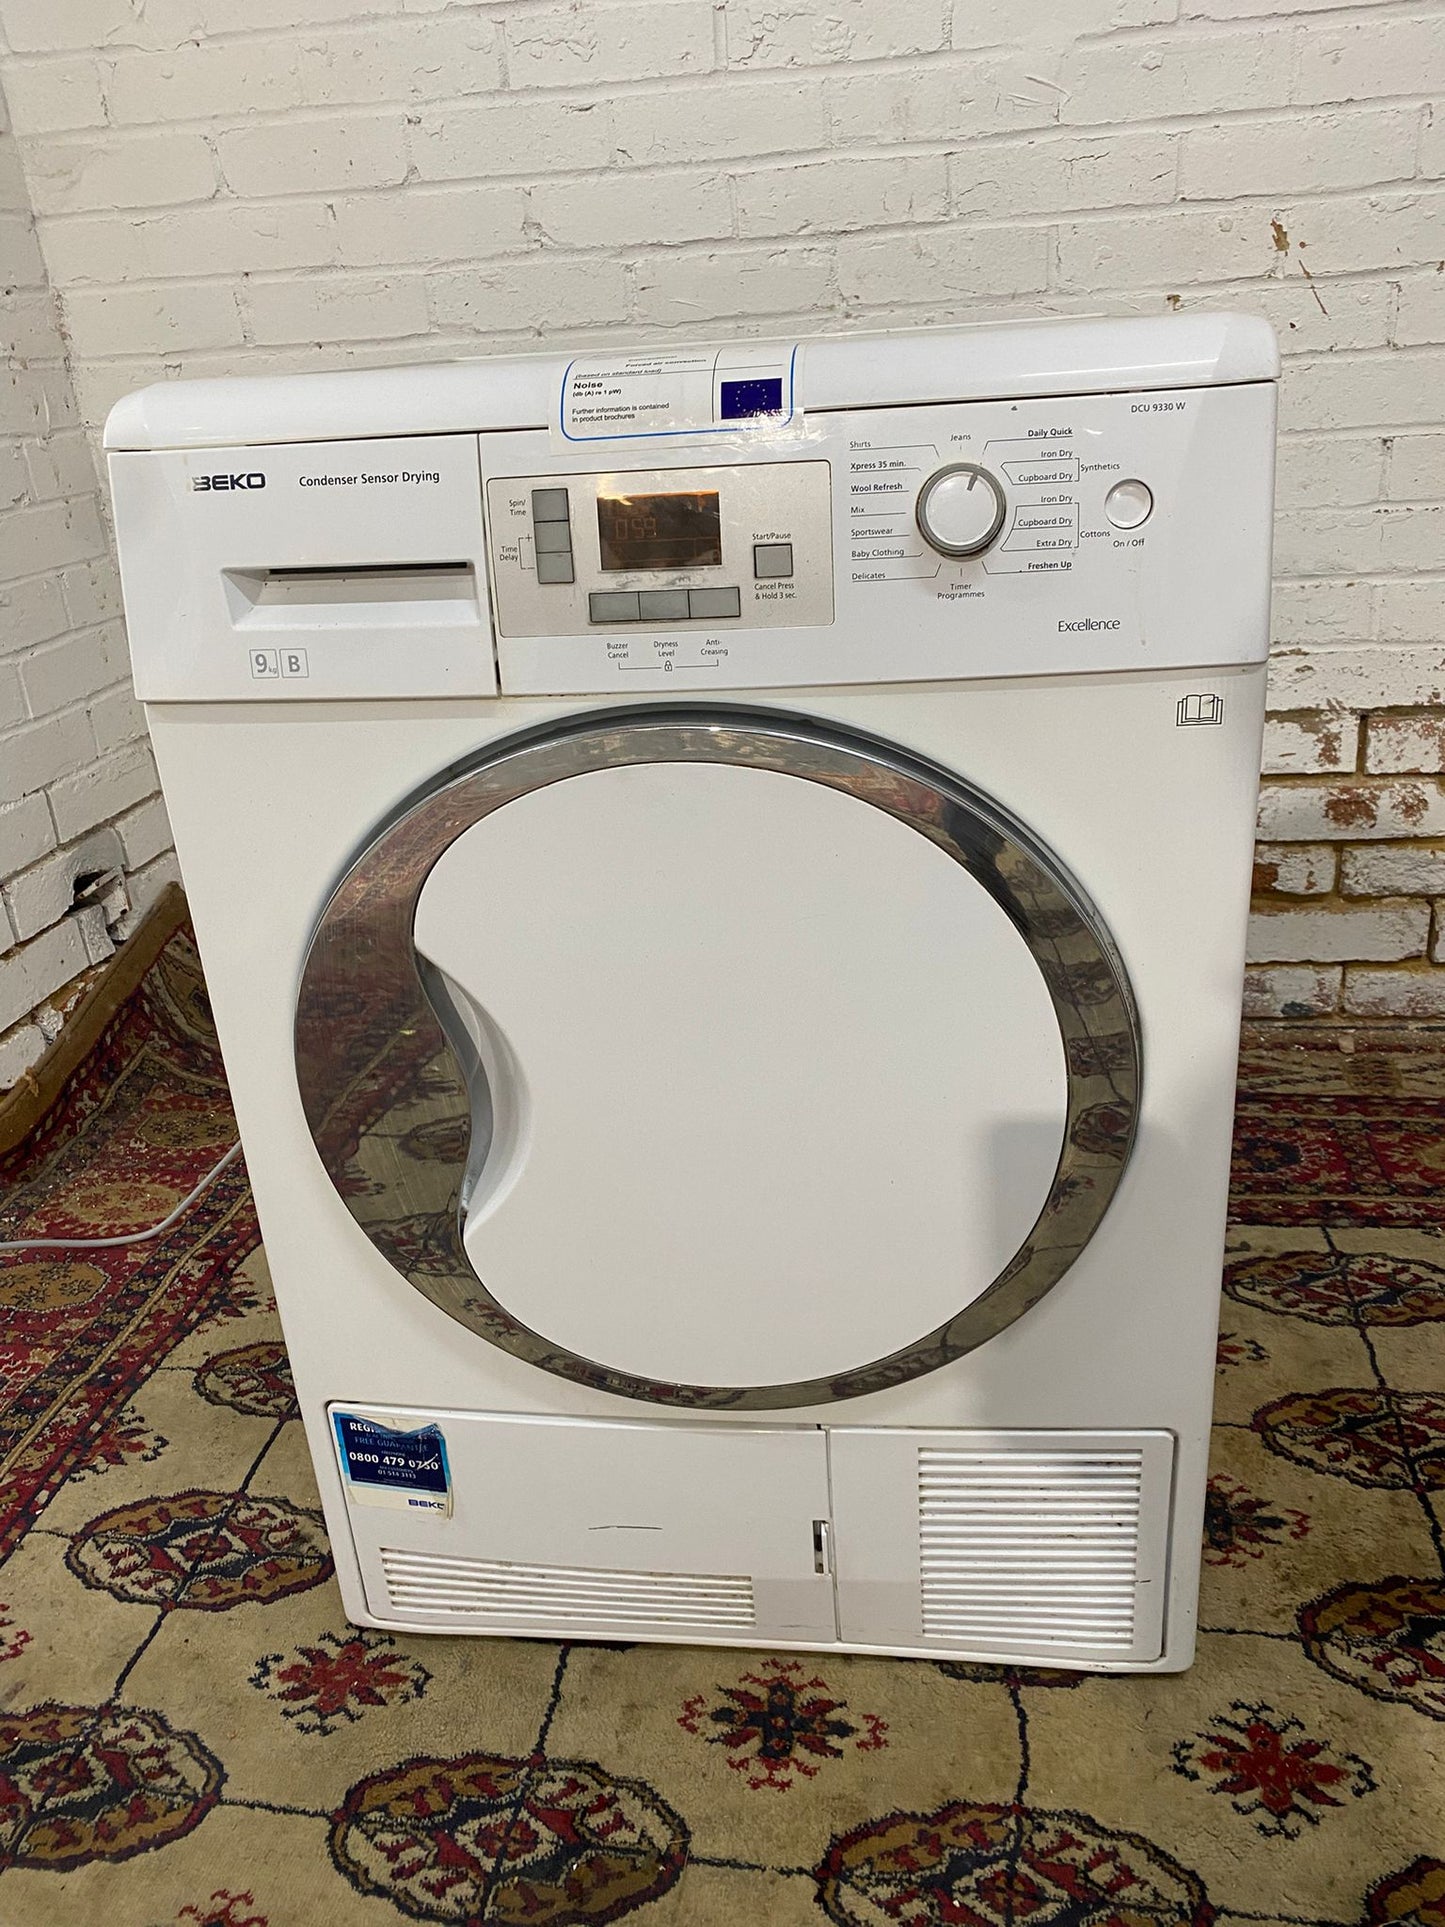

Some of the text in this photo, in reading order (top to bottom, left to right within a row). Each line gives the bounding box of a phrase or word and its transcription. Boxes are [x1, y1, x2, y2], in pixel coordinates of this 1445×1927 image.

[573, 381, 603, 390] Noise
[572, 407, 595, 415] Further
[595, 405, 631, 414] information
[639, 402, 670, 410] contained
[1131, 402, 1186, 413] DCU 9330 W
[580, 414, 604, 423] product
[604, 412, 636, 421] brochures
[950, 433, 971, 442] Jeans
[1027, 427, 1073, 439] Daily Quick
[1041, 450, 1073, 458] Iron Dry
[850, 462, 876, 471] Xpress
[1080, 463, 1121, 473] Synthetics
[299, 470, 440, 487] Condenser Sensor Drying
[1018, 472, 1073, 482] Cupboard Dry
[192, 473, 266, 491] BEKO
[850, 482, 903, 492] Wool Refresh
[1059, 495, 1073, 503] Dry
[1018, 517, 1072, 526] Cupboard Dry
[752, 532, 791, 540] Start/Pause
[851, 528, 893, 537] Sportswear
[1080, 530, 1111, 538] Cottons
[1036, 539, 1072, 548] Extra Dry
[1113, 539, 1125, 547] On
[1132, 538, 1145, 546] Off
[500, 554, 518, 562] Delay
[851, 549, 905, 558] Baby Clothing
[1028, 561, 1072, 570] Freshen Up
[851, 572, 886, 580] Delicates
[937, 591, 985, 600] Programmes
[1058, 617, 1121, 632] Excellence
[653, 641, 679, 649] Dryness
[658, 649, 675, 657] Level
[700, 647, 729, 656] Creasing
[287, 655, 301, 672] B
[349, 1451, 379, 1463] 0800
[383, 1456, 405, 1466] 479
